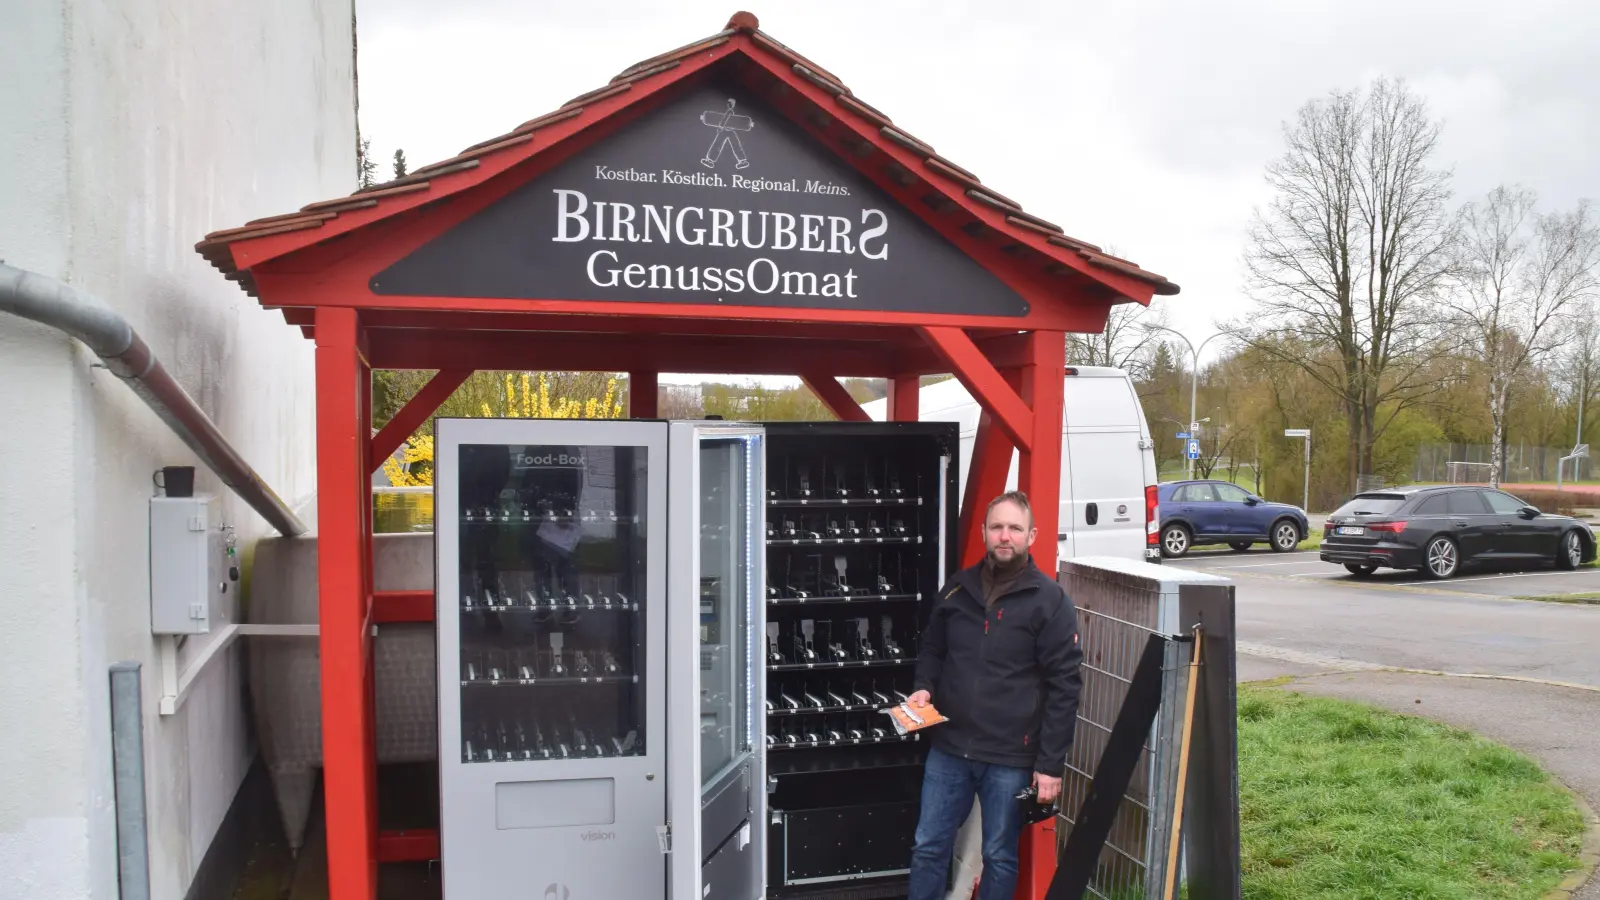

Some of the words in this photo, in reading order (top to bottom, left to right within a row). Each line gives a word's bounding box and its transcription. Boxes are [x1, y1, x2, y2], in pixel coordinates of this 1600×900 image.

[595, 165, 657, 183] Kostbar.
[662, 169, 727, 187] Köstlich.
[732, 174, 800, 192] Regional.
[804, 179, 851, 196] Meins.
[586, 249, 858, 298] GenussOmat
[516, 453, 586, 465] Food-Box
[580, 830, 616, 841] vision
